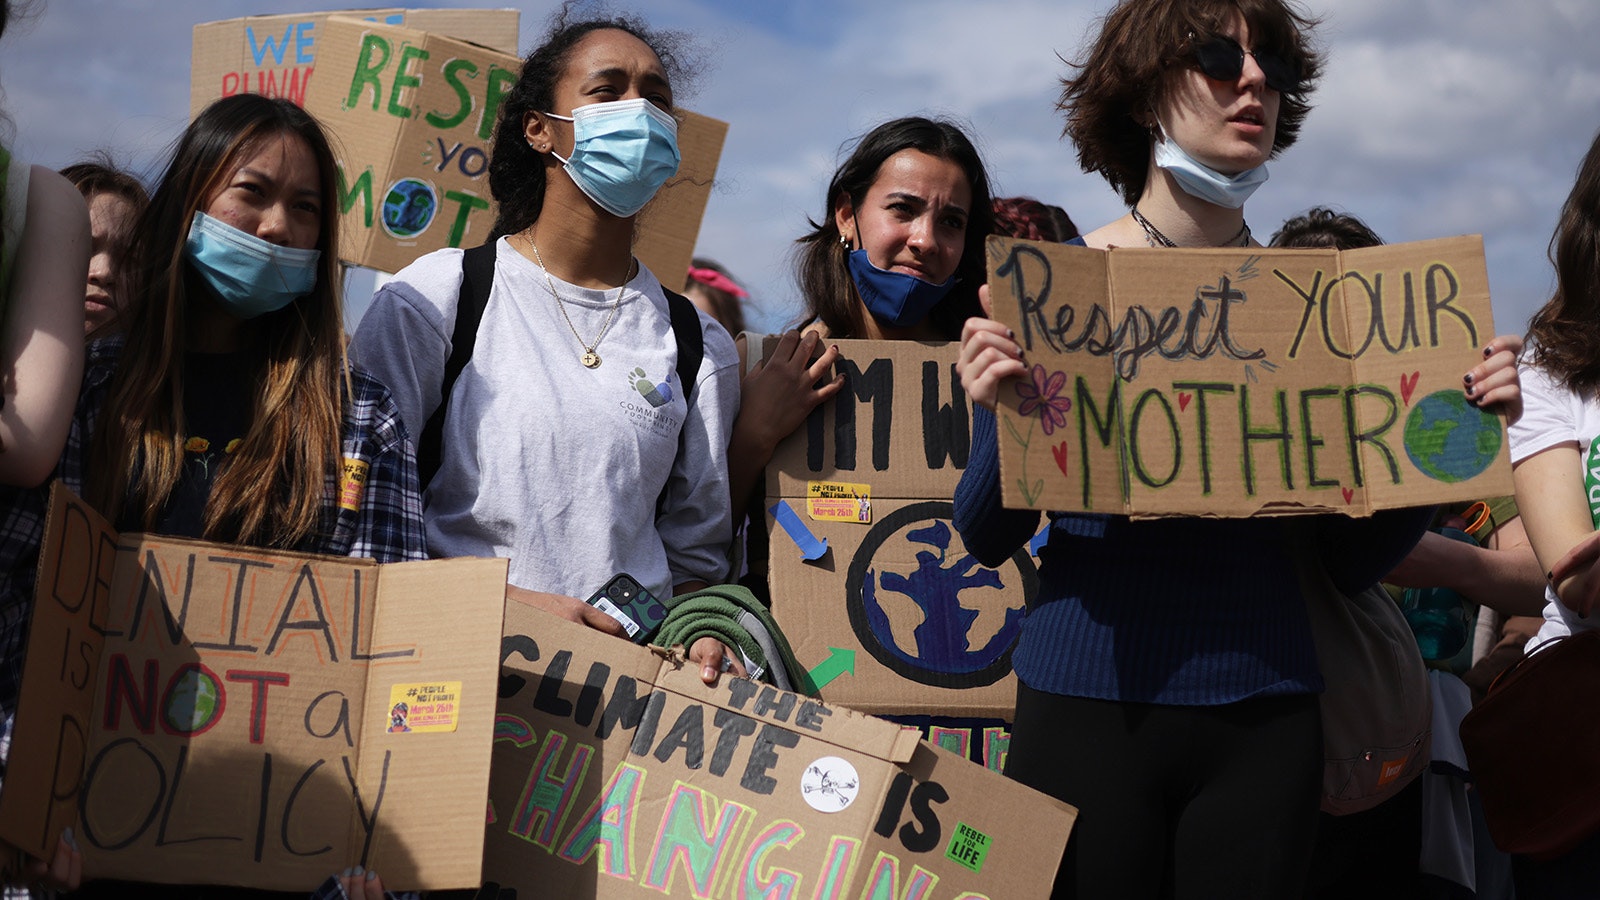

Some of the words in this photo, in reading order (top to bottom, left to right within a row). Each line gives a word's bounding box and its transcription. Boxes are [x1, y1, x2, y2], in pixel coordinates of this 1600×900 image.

[246, 22, 315, 67] WE
[347, 34, 518, 140] RESP
[436, 137, 489, 177] YO
[996, 243, 1267, 382] Respect
[1272, 263, 1479, 361] YOUR
[620, 401, 677, 428] COMMUNITY
[1074, 375, 1402, 508] MOTHER
[813, 508, 836, 516] March
[52, 502, 417, 664] DENIAL
[60, 627, 95, 691] IS
[104, 653, 290, 744] NOT
[304, 690, 354, 748] a
[410, 704, 434, 714] March
[416, 694, 432, 703] NOT
[420, 685, 446, 694] PEOPLE
[728, 677, 833, 732] THE
[499, 634, 801, 795] CLIMATE
[874, 772, 950, 853] IS
[42, 714, 391, 868] POLICY
[485, 713, 990, 900] HANGI
[951, 841, 980, 865] LIFE
[960, 825, 986, 845] REBEL
[963, 837, 976, 848] FOR
